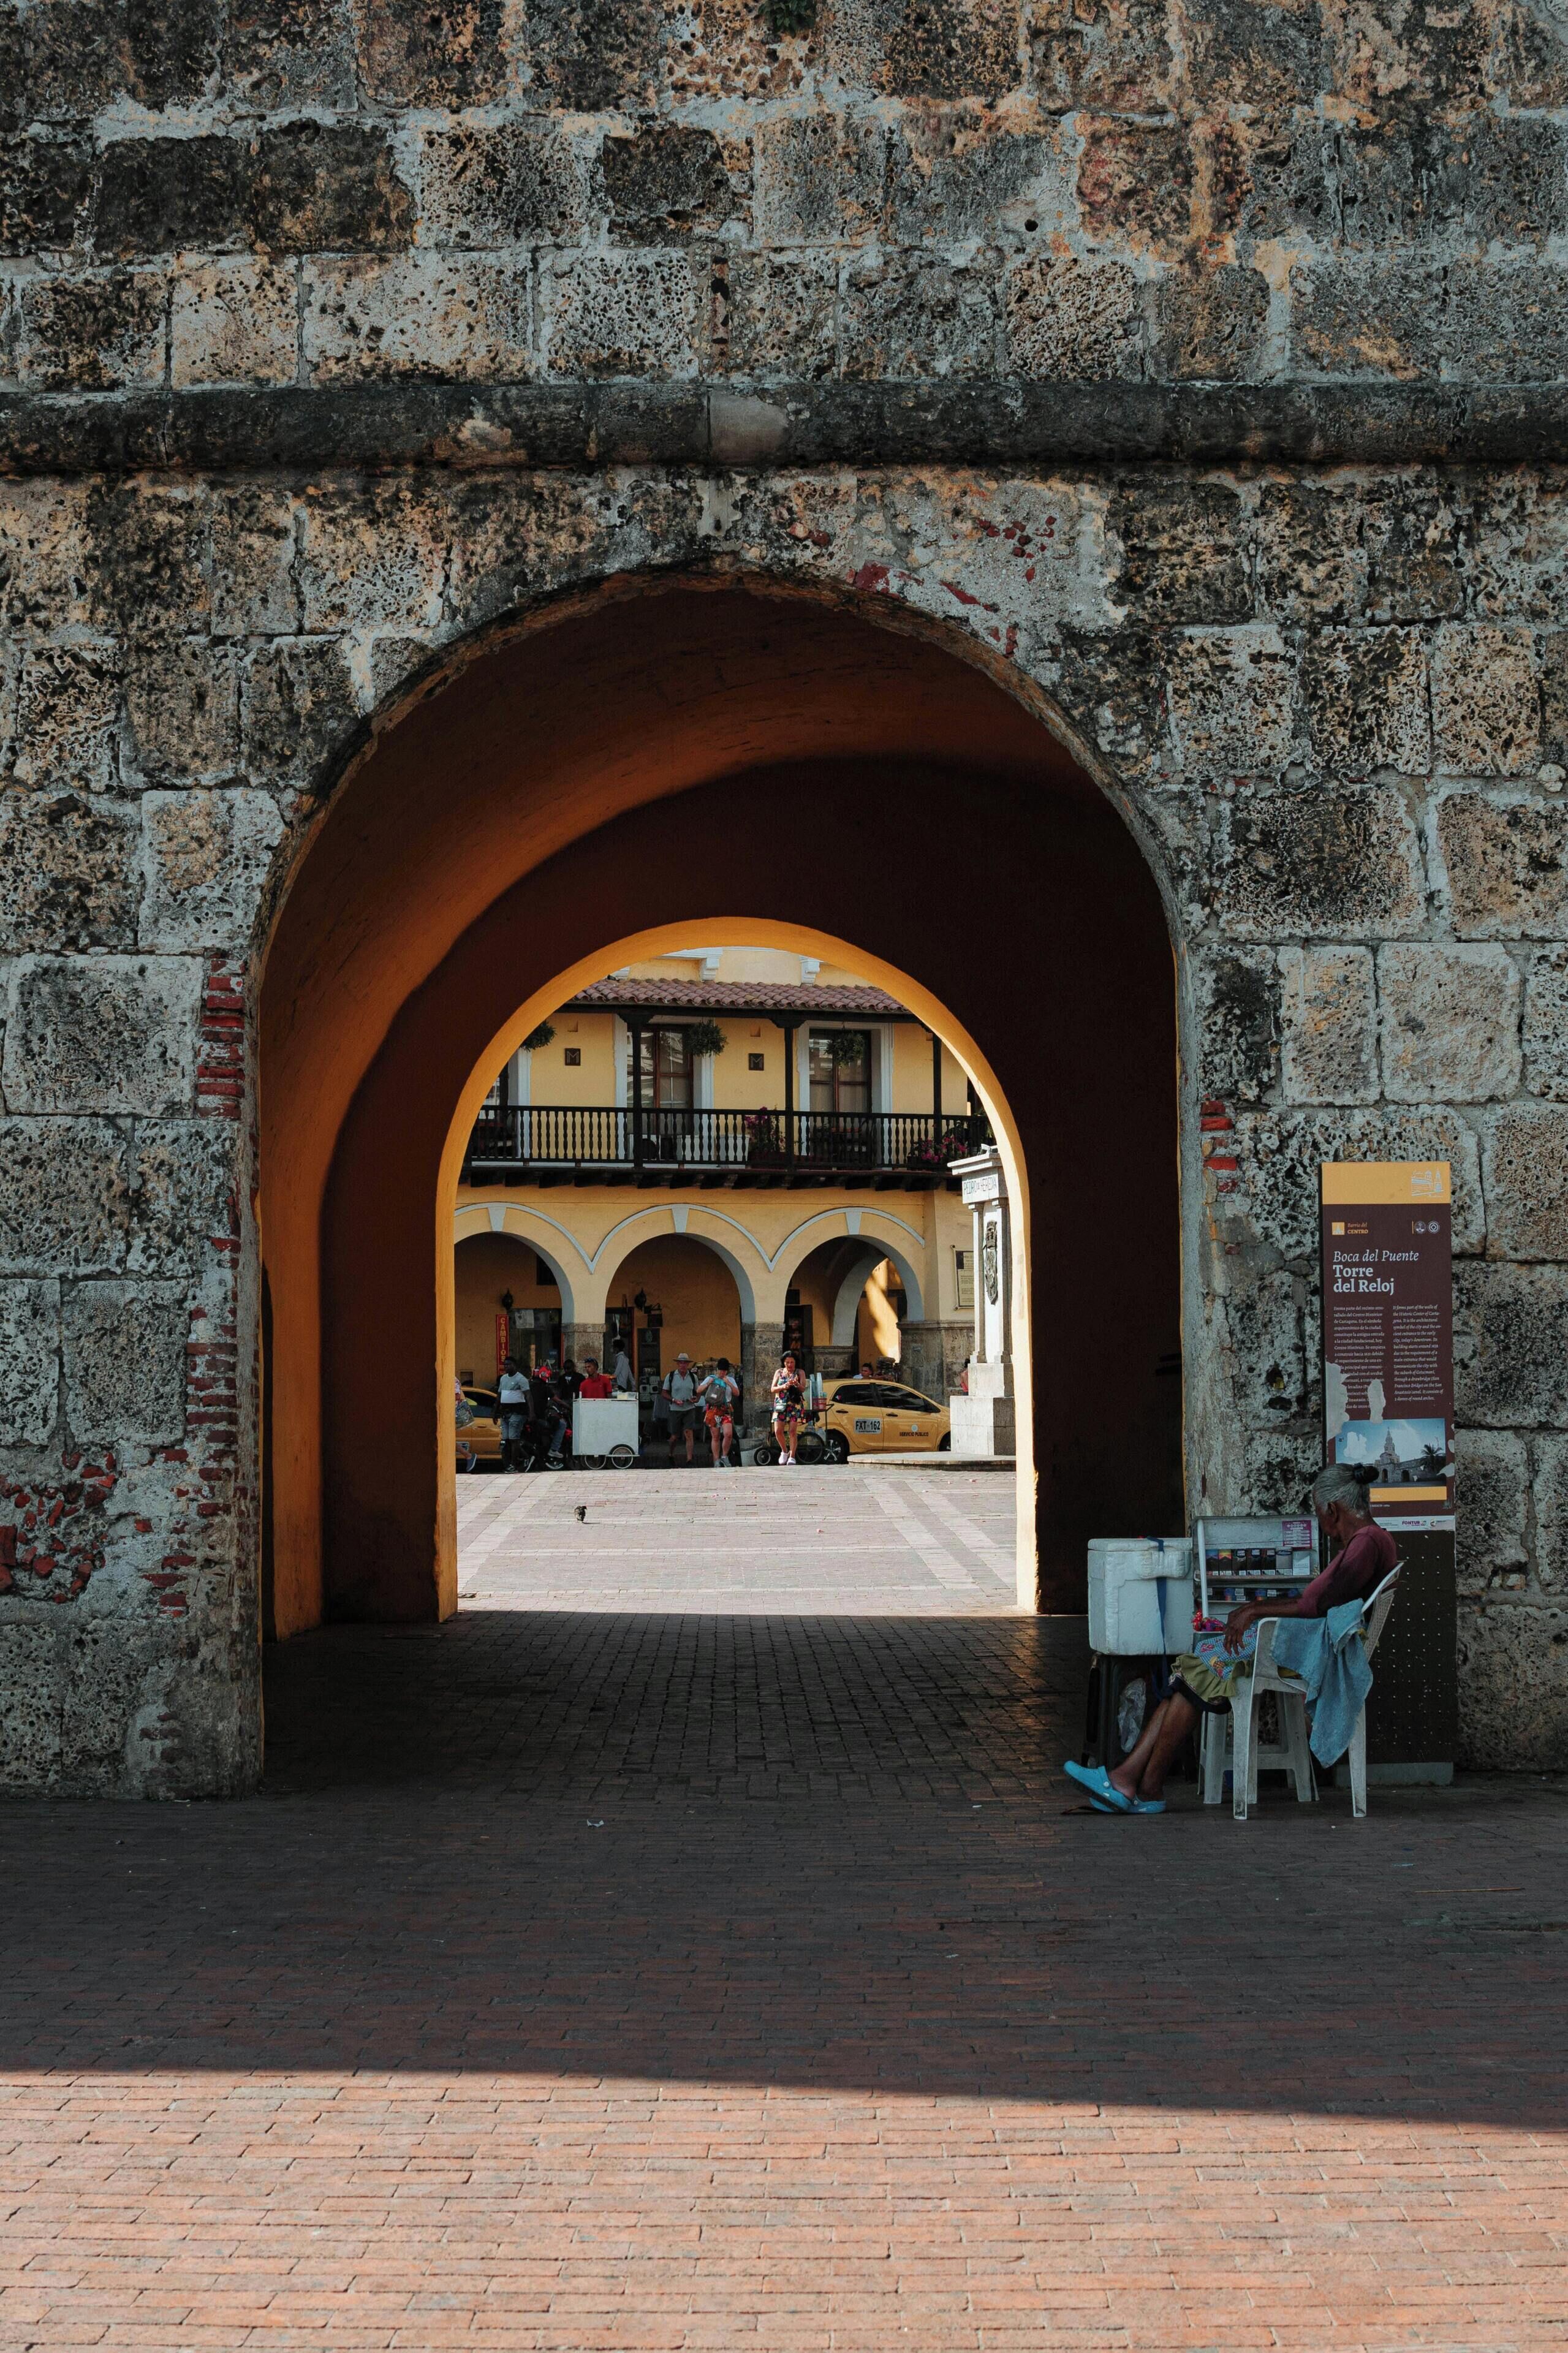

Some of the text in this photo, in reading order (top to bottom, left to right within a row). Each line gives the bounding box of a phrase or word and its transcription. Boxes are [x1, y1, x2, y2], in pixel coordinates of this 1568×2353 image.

[963, 1180, 977, 1195] PEDRO
[980, 1176, 998, 1192] HEREDIA
[1333, 1249, 1419, 1262] Boca del Puente
[1333, 1265, 1374, 1278] Torre
[1333, 1278, 1395, 1295] del Reloj
[855, 1420, 881, 1430] FXT 162
